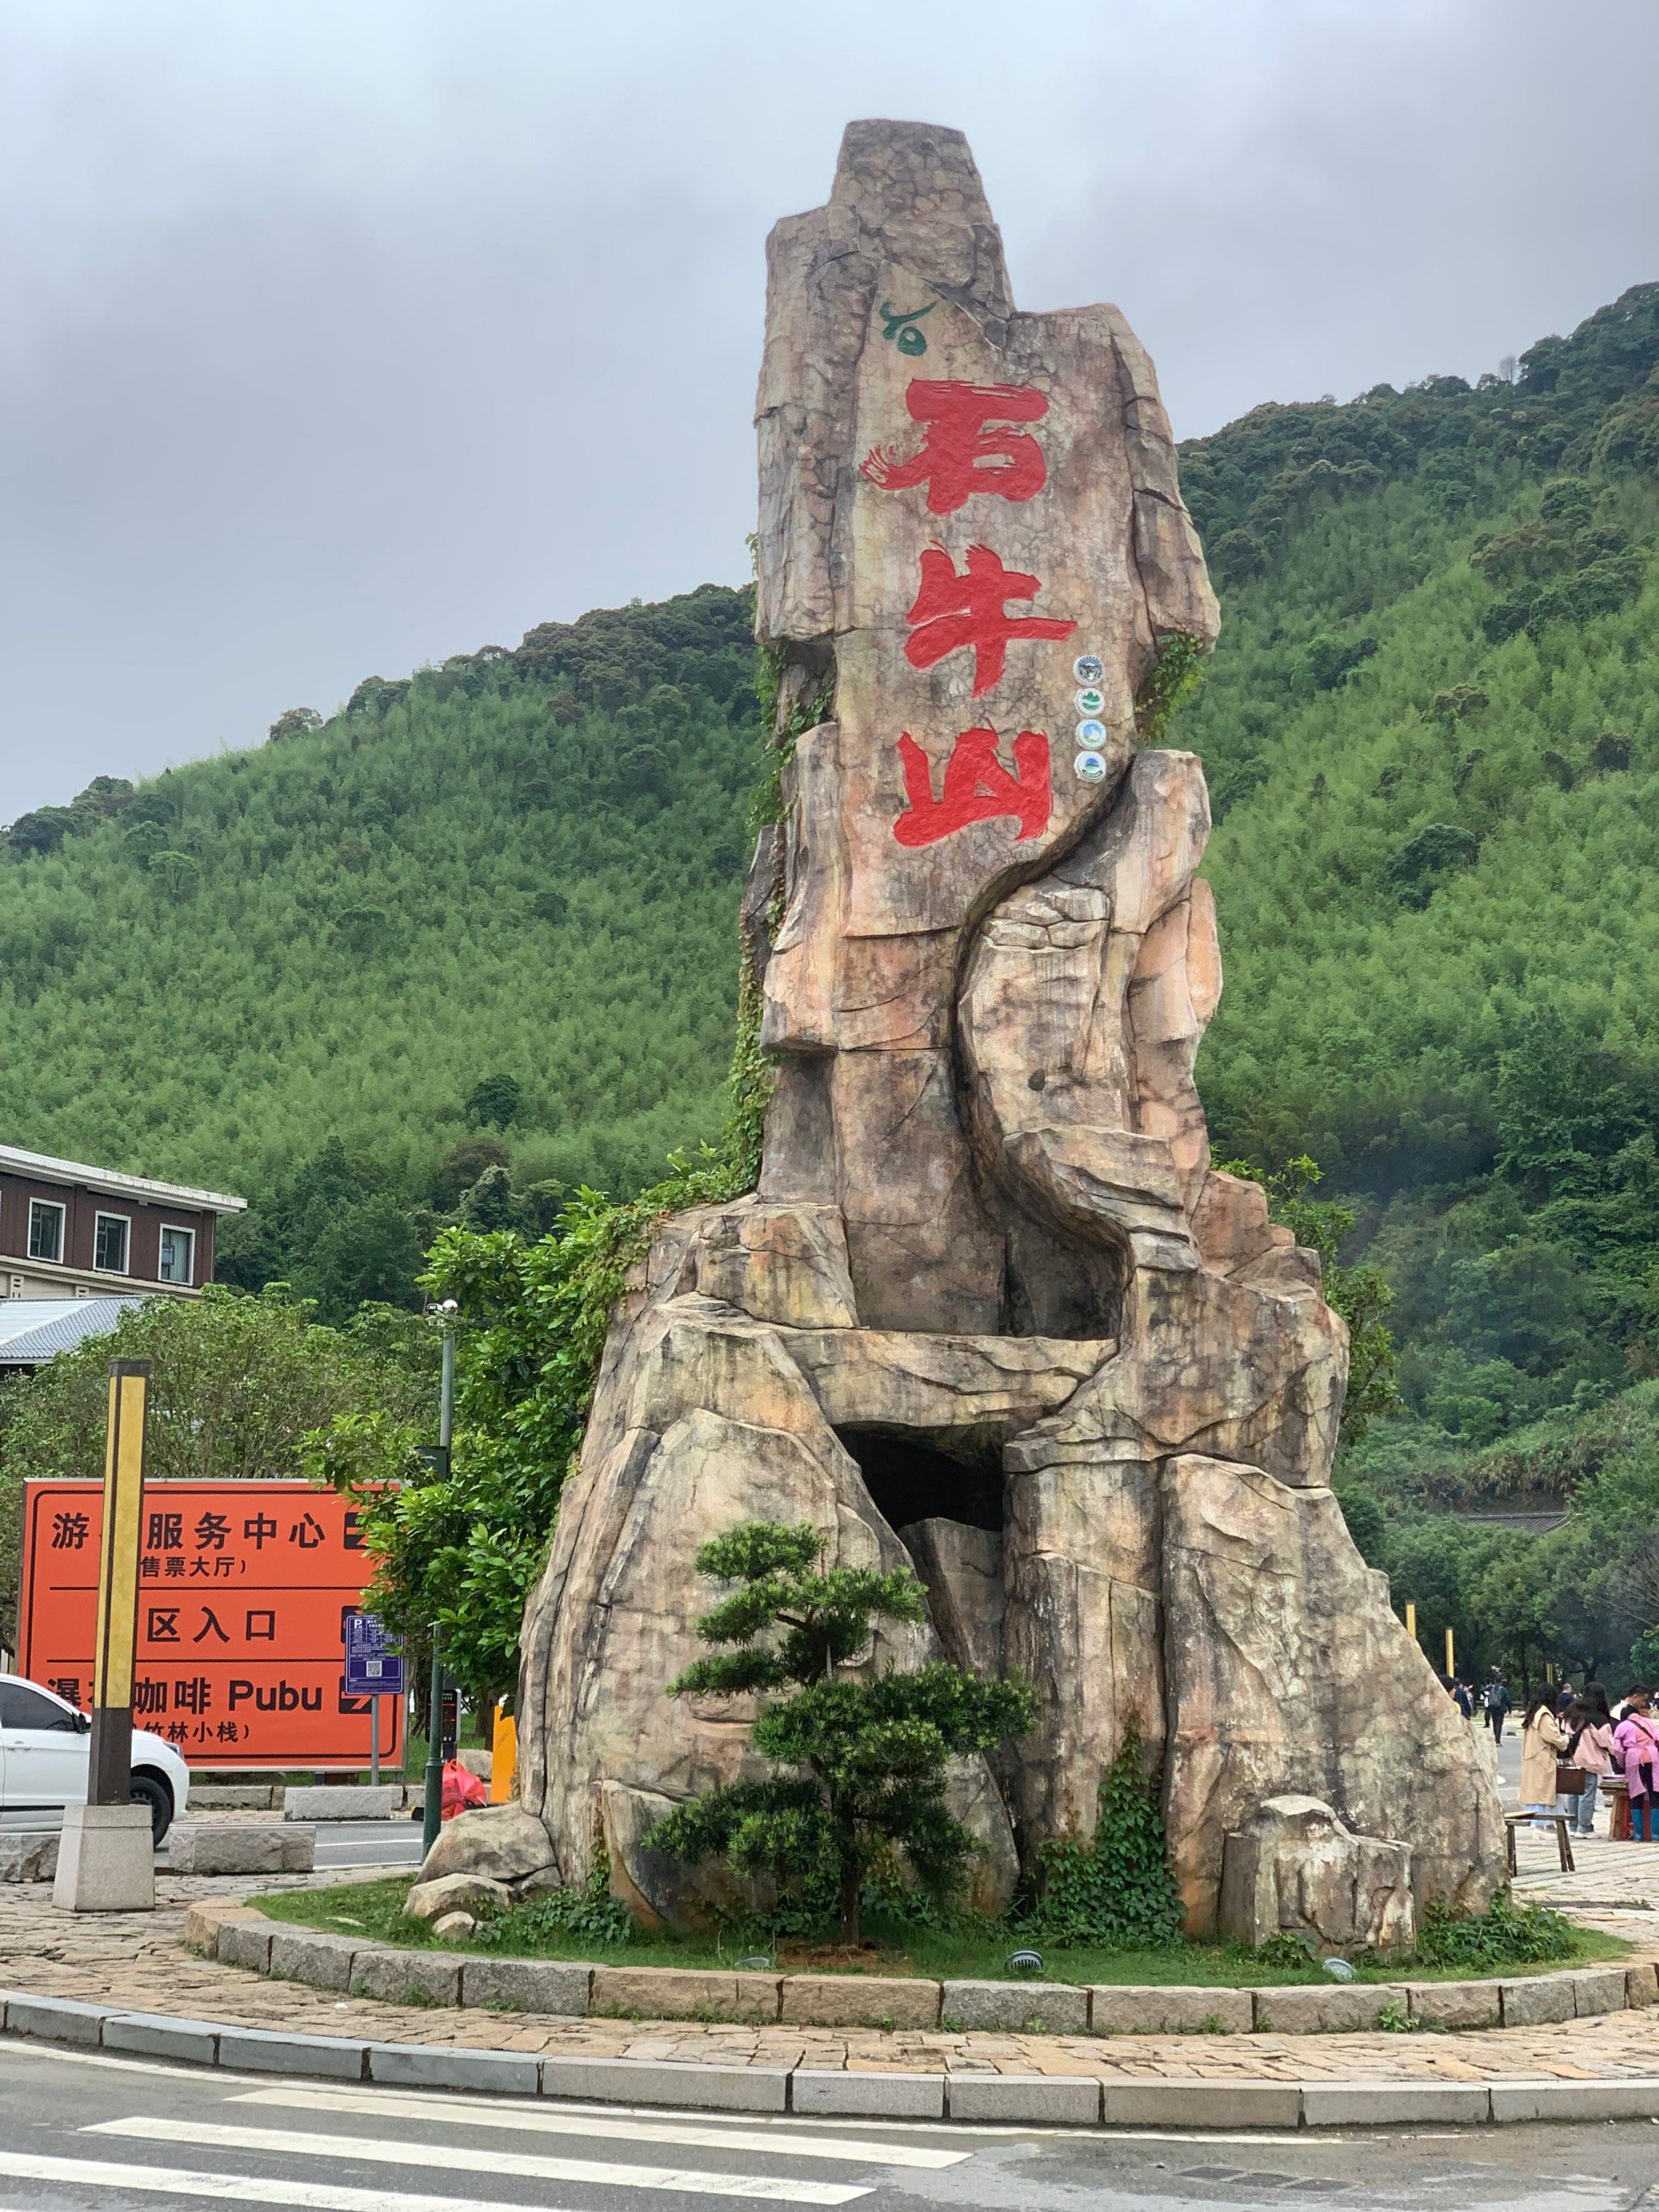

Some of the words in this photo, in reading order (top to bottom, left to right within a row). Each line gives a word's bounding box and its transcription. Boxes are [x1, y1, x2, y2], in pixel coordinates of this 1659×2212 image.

[859, 378, 1078, 848] 石牛山
[51, 1513, 326, 1550] 游服务中心
[47, 1677, 211, 1715] 瀑咖啡
[228, 1680, 322, 1711] Pubu
